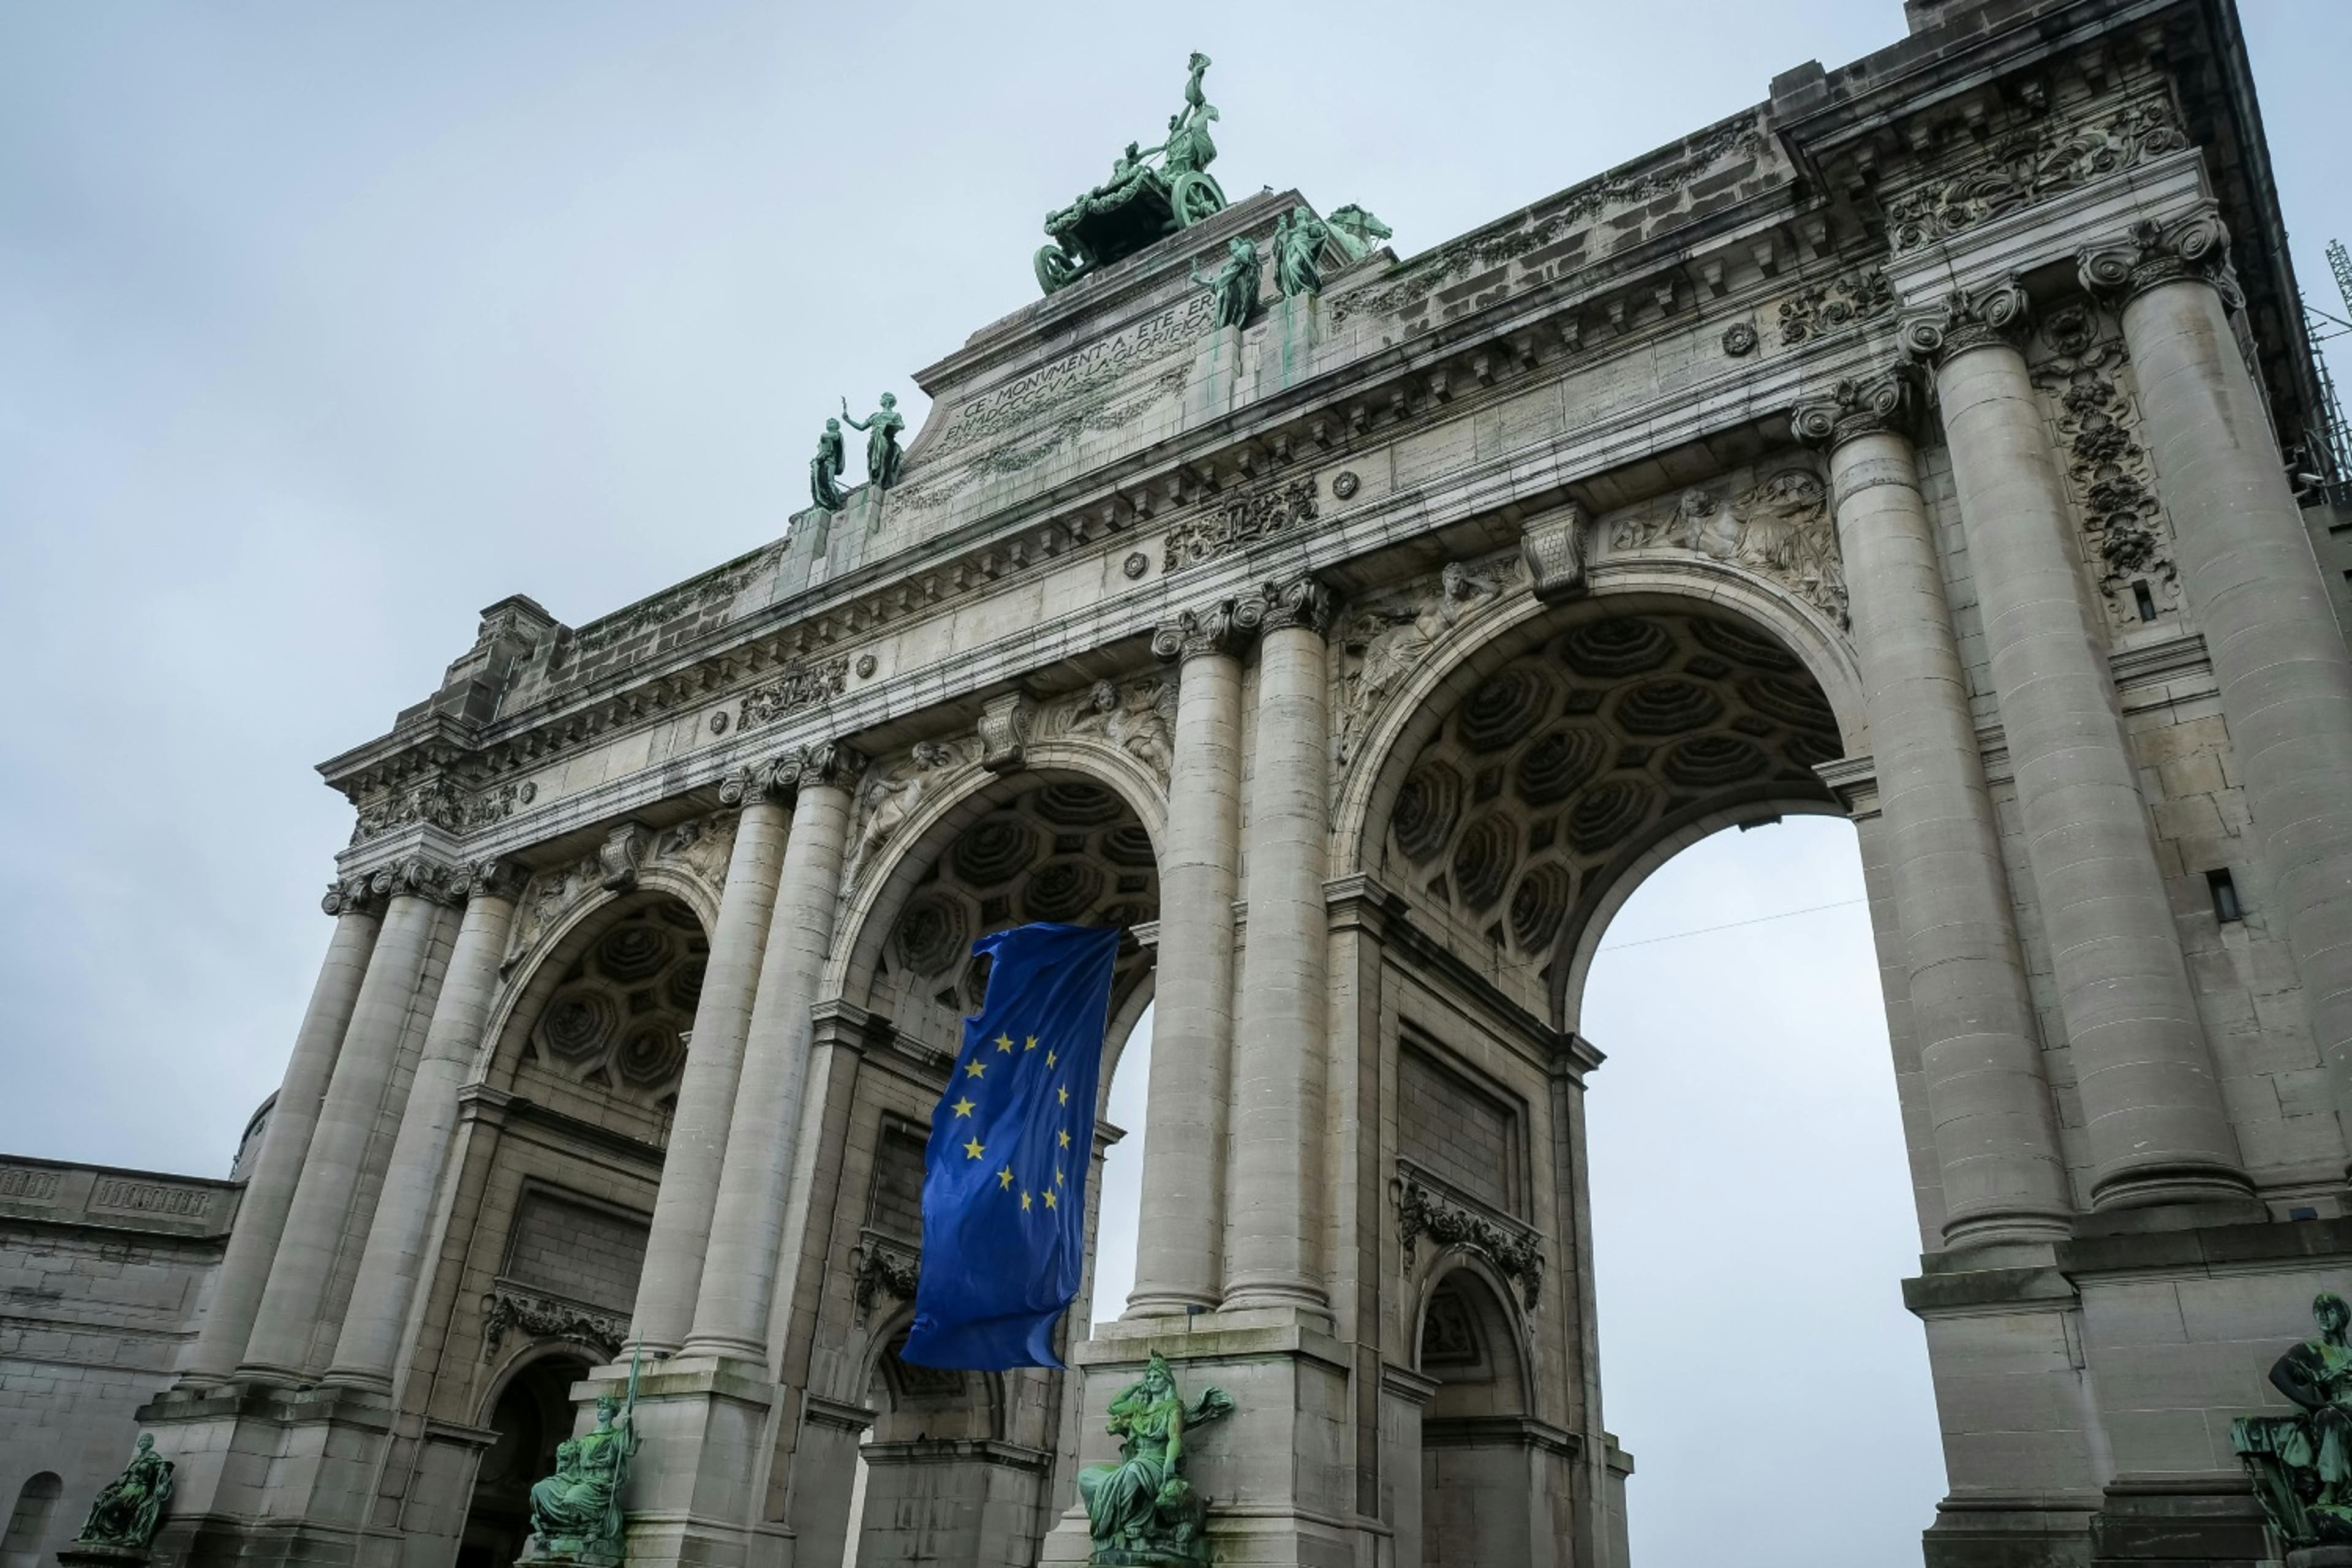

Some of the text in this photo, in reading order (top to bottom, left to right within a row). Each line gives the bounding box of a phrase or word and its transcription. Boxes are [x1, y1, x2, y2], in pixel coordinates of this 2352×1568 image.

[964, 398, 987, 418] CE
[1112, 336, 1126, 352] A
[1137, 310, 1175, 339] ETE
[1188, 294, 1215, 316] ER
[1085, 357, 1109, 377] LA
[1113, 307, 1215, 363] GLORIFICA
